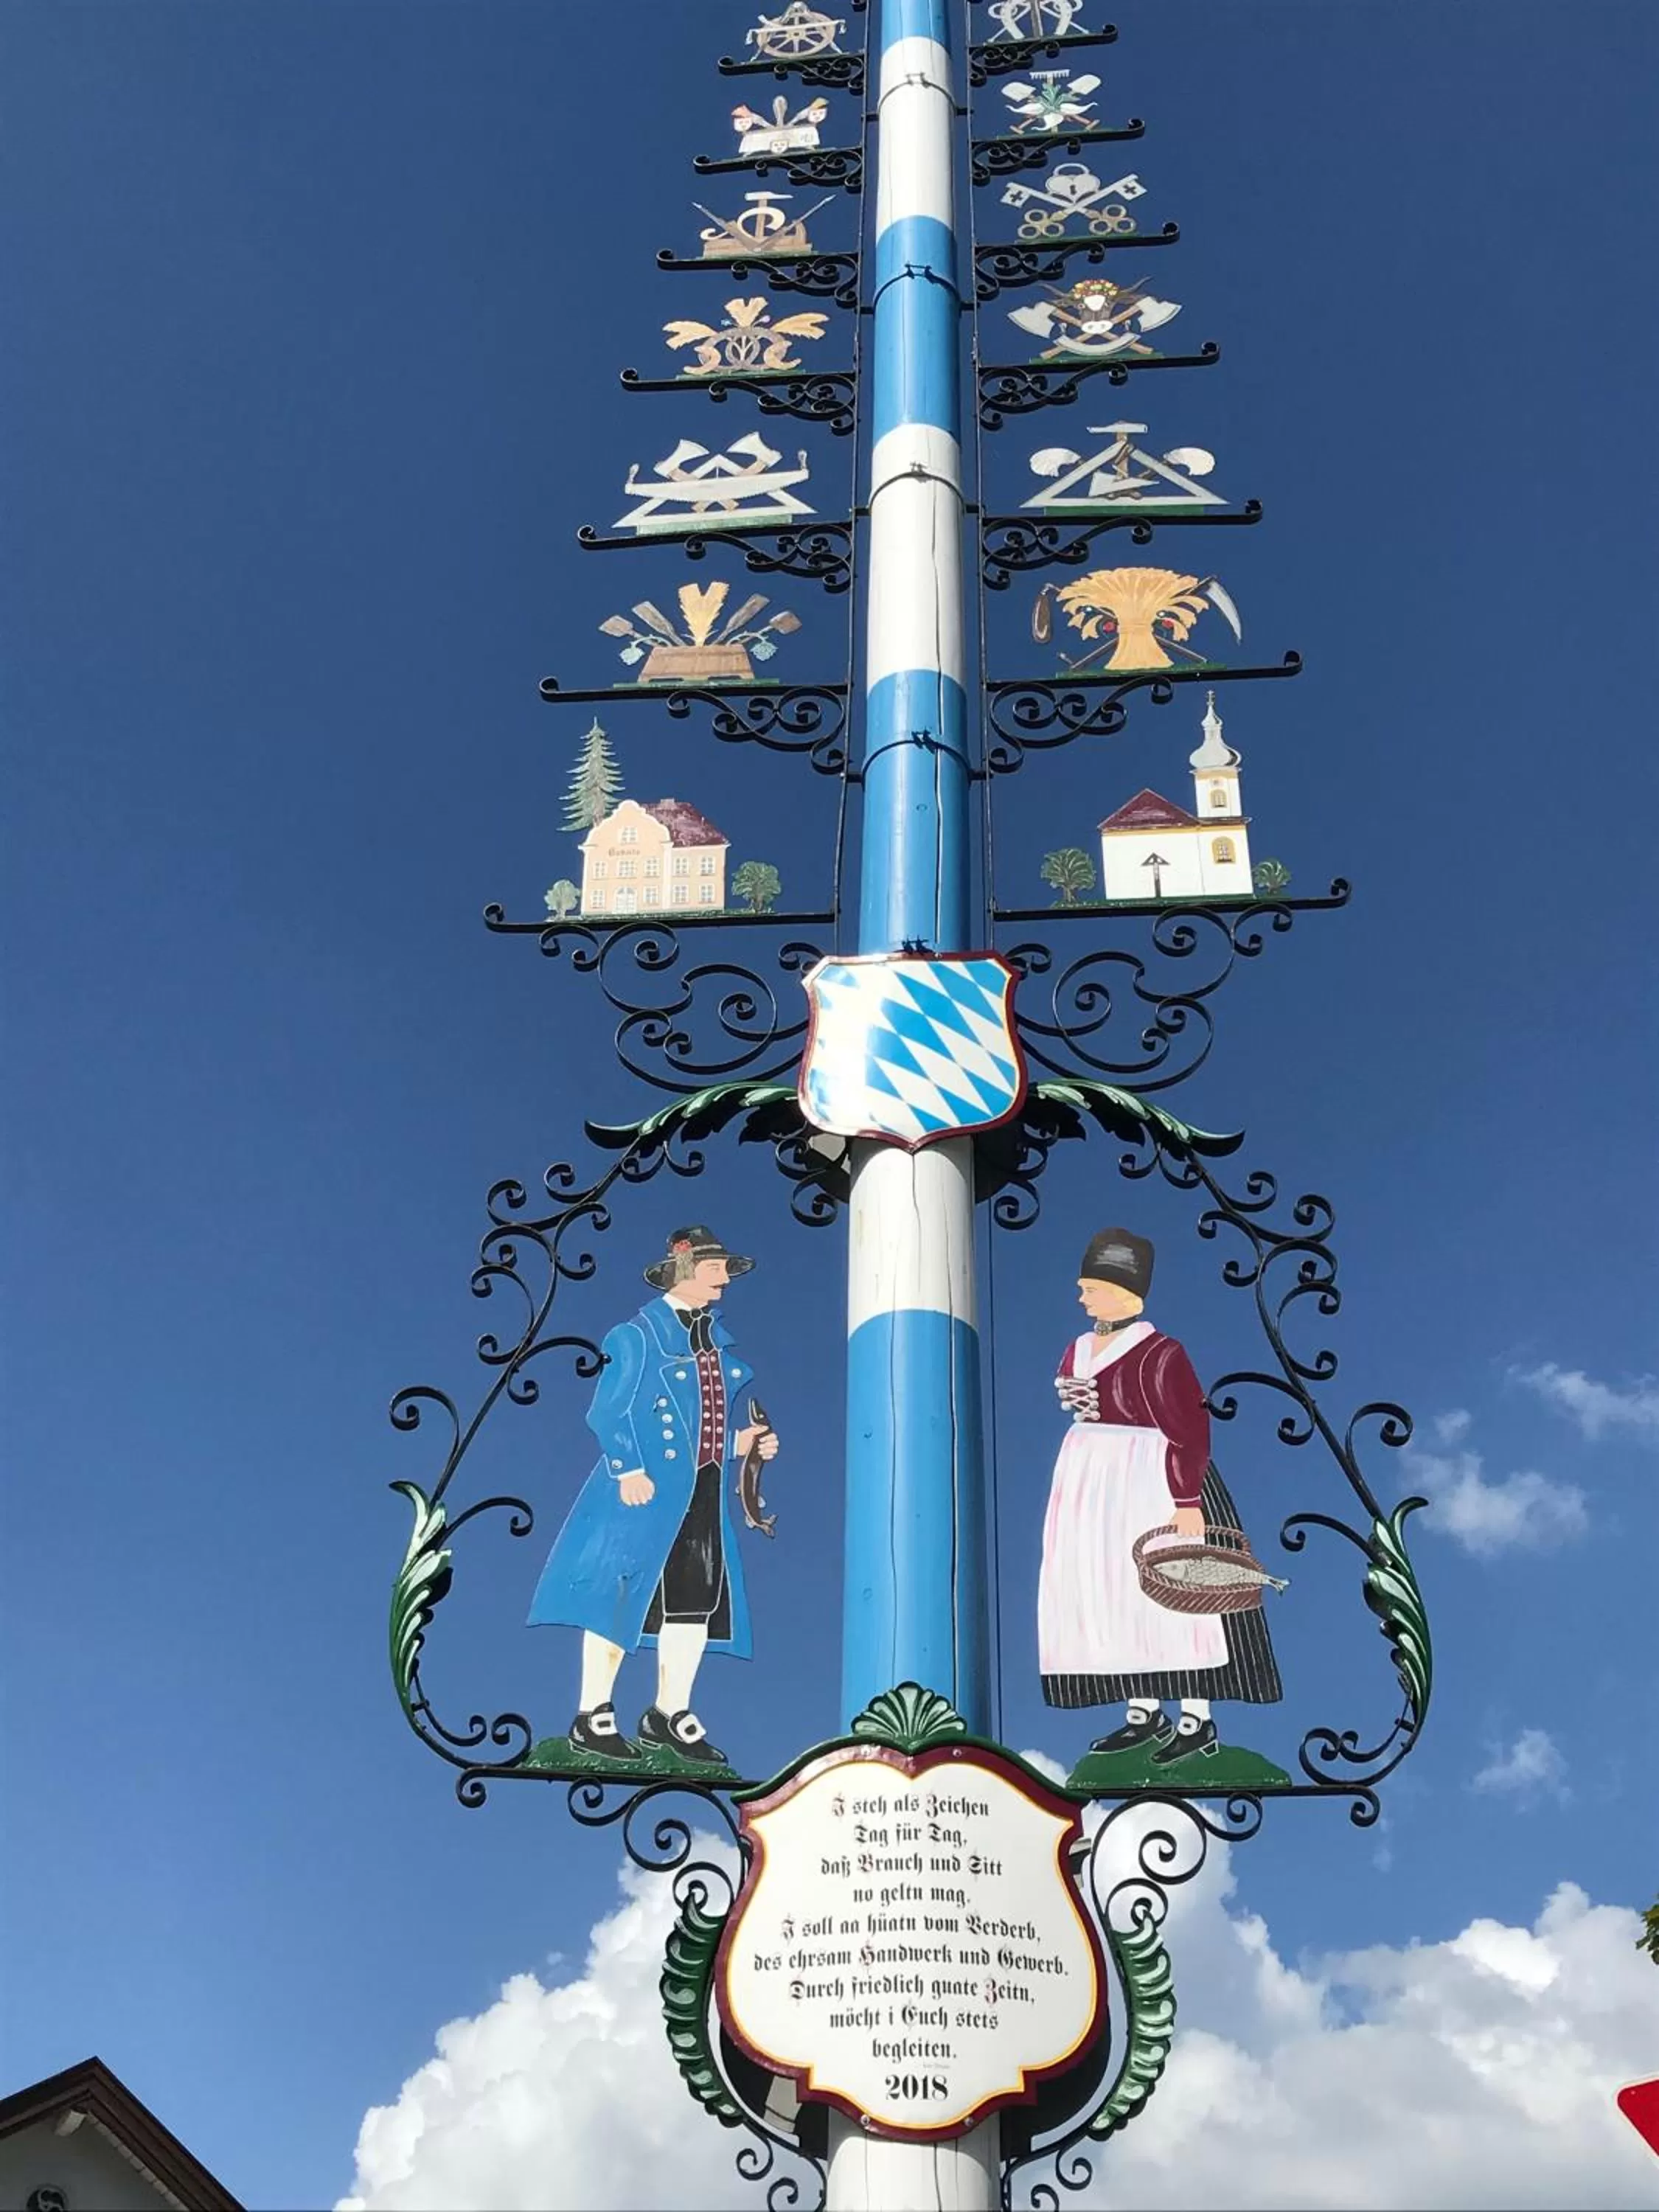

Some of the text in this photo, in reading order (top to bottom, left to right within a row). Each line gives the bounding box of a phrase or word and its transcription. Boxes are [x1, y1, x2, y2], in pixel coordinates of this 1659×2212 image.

[852, 1795, 886, 1816] steh
[894, 1794, 919, 1812] als
[925, 1793, 989, 1819] Zeichen
[854, 1822, 967, 1848] Tag für Tag,
[821, 1851, 1002, 1878] daß Brauch und Sitt
[853, 1882, 970, 1908] no geltn mag.
[802, 1916, 833, 1937] soll
[840, 1919, 860, 1934] aa
[867, 1913, 917, 1936] hüatn
[924, 1916, 959, 1933] vom
[965, 1914, 1040, 1944] Verderb,
[754, 1942, 1068, 1975] des ehrsam Handwerk und Gewerb.
[790, 1975, 1034, 2005] Durch friedlich guate Zeitn,
[830, 2003, 998, 2029] möcht i Euch stets
[872, 2037, 956, 2063] begleiten.
[885, 2074, 948, 2100] 2018
